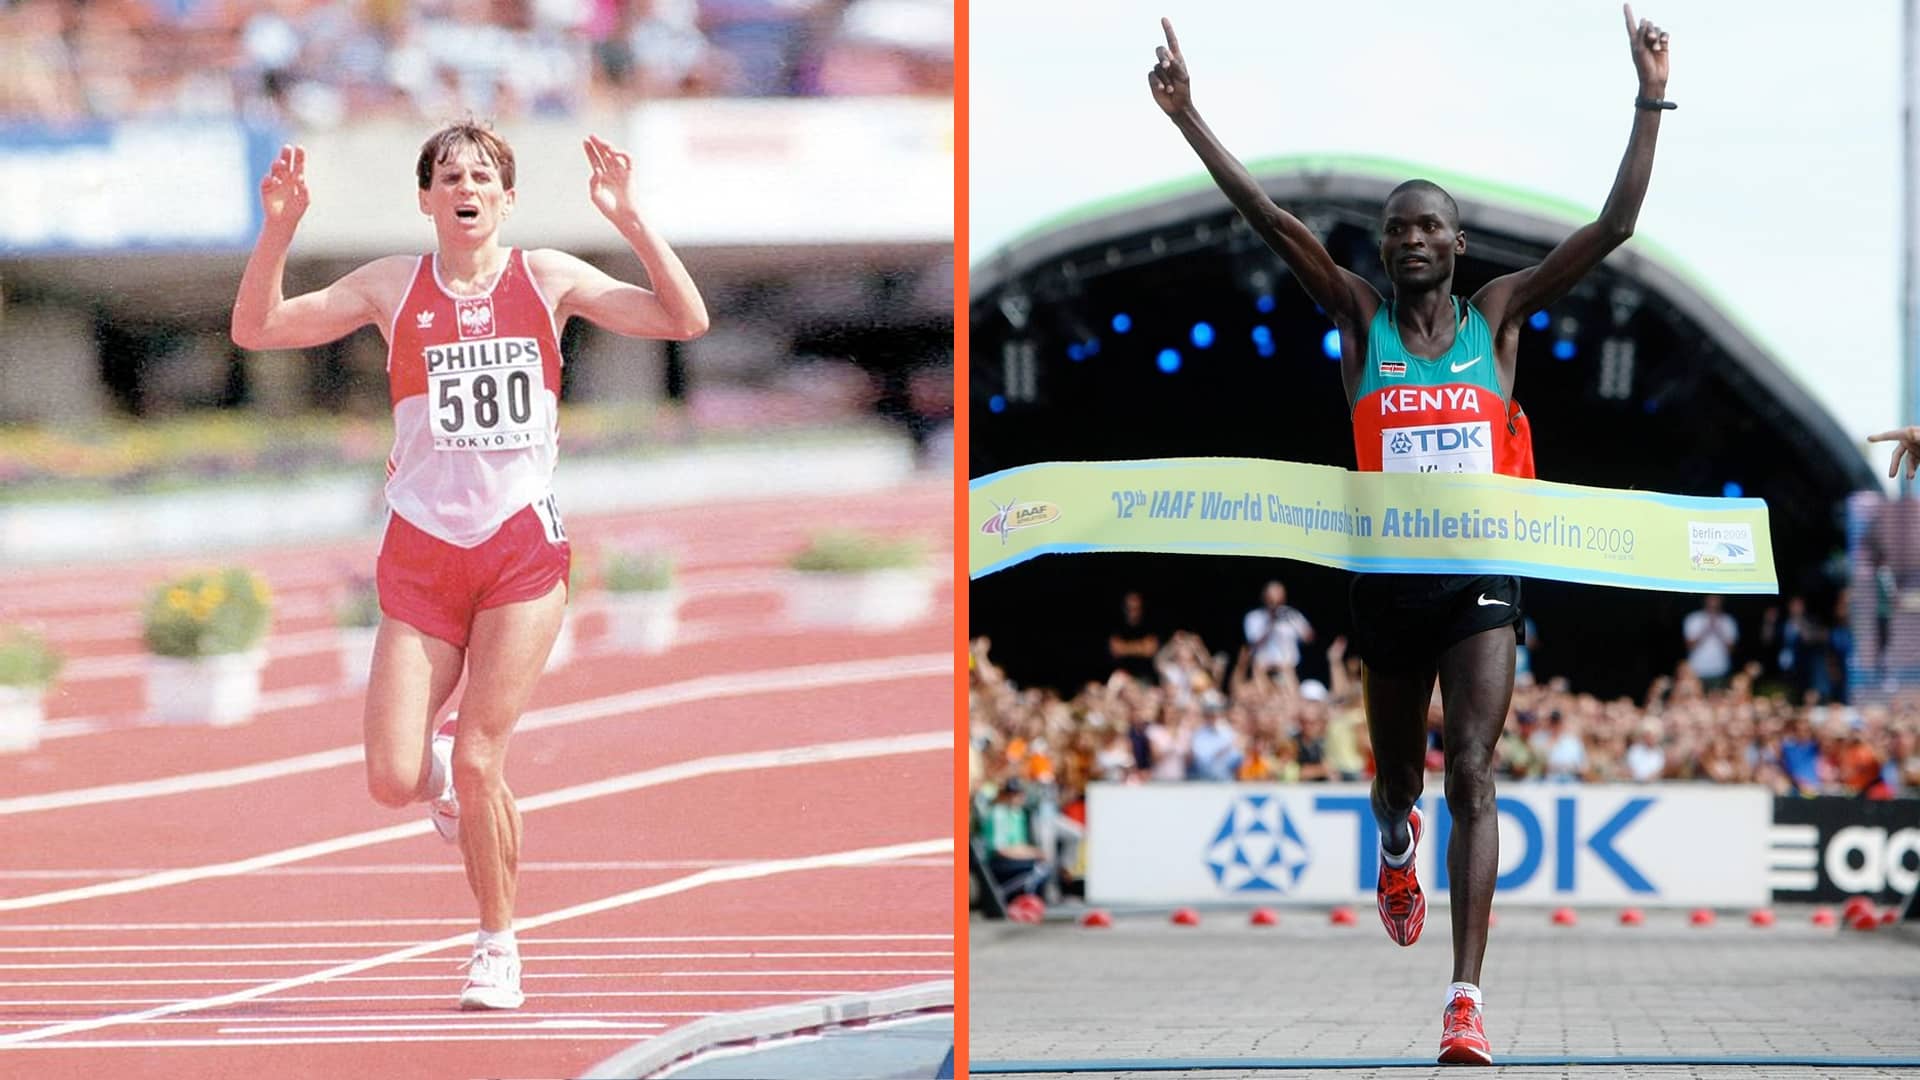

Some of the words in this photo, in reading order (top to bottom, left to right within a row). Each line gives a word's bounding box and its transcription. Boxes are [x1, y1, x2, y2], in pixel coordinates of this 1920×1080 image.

[426, 341, 539, 372] PHILIPS
[439, 371, 531, 433] 580
[1380, 387, 1480, 416] KENYA
[446, 435, 505, 448] TOKYO
[1411, 426, 1484, 452] TDK
[1016, 505, 1047, 519] IAAF
[1111, 490, 1147, 519] 12th
[1149, 490, 1196, 519] IAAF
[1200, 491, 1263, 522] World
[1355, 507, 1372, 537] in
[1382, 508, 1509, 539] Athletics
[1514, 509, 1581, 549] berlin
[1586, 526, 1635, 554] 2009
[1692, 527, 1722, 540] berlin
[1315, 796, 1658, 893] TDK
